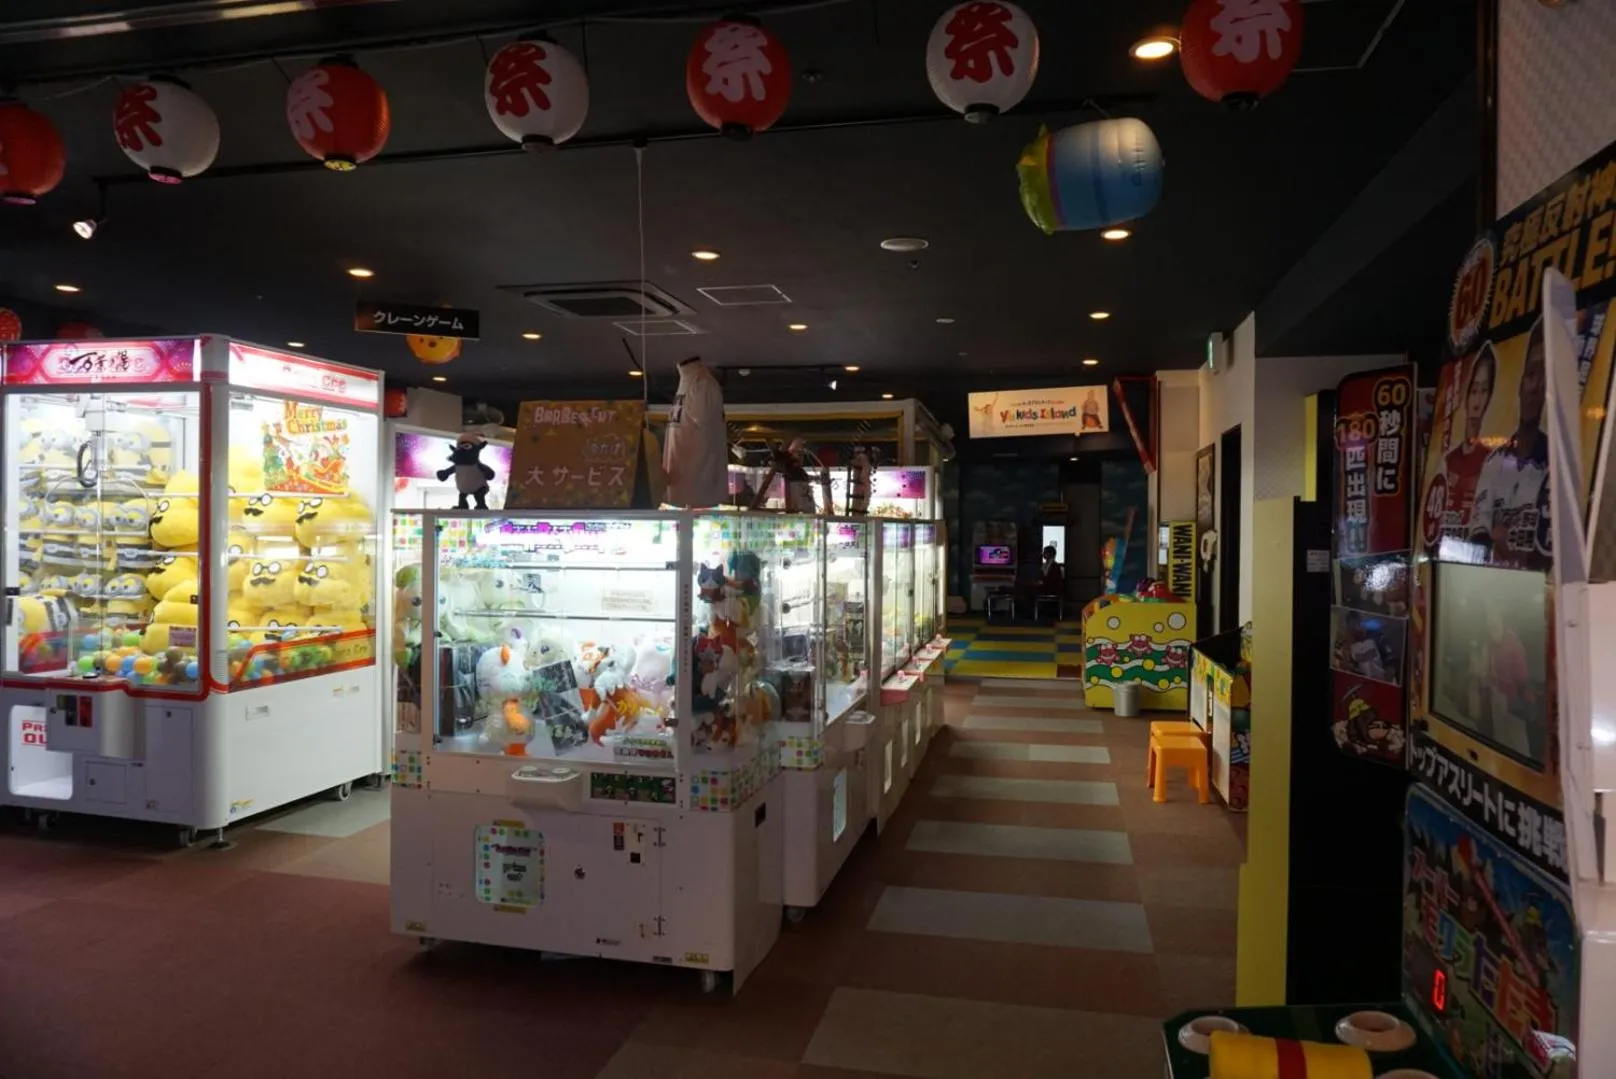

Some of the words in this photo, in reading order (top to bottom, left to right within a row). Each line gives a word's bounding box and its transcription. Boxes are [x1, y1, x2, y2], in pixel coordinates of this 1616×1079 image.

[701, 22, 772, 101] 祭
[944, 2, 1019, 82] 祭
[1209, 0, 1293, 63] 祭
[287, 68, 334, 140] 祭
[488, 42, 551, 117] 祭
[116, 84, 162, 151] 祭
[374, 310, 465, 331] クレーンゲーム
[286, 419, 348, 434] Christmas
[552, 466, 625, 486] サービス
